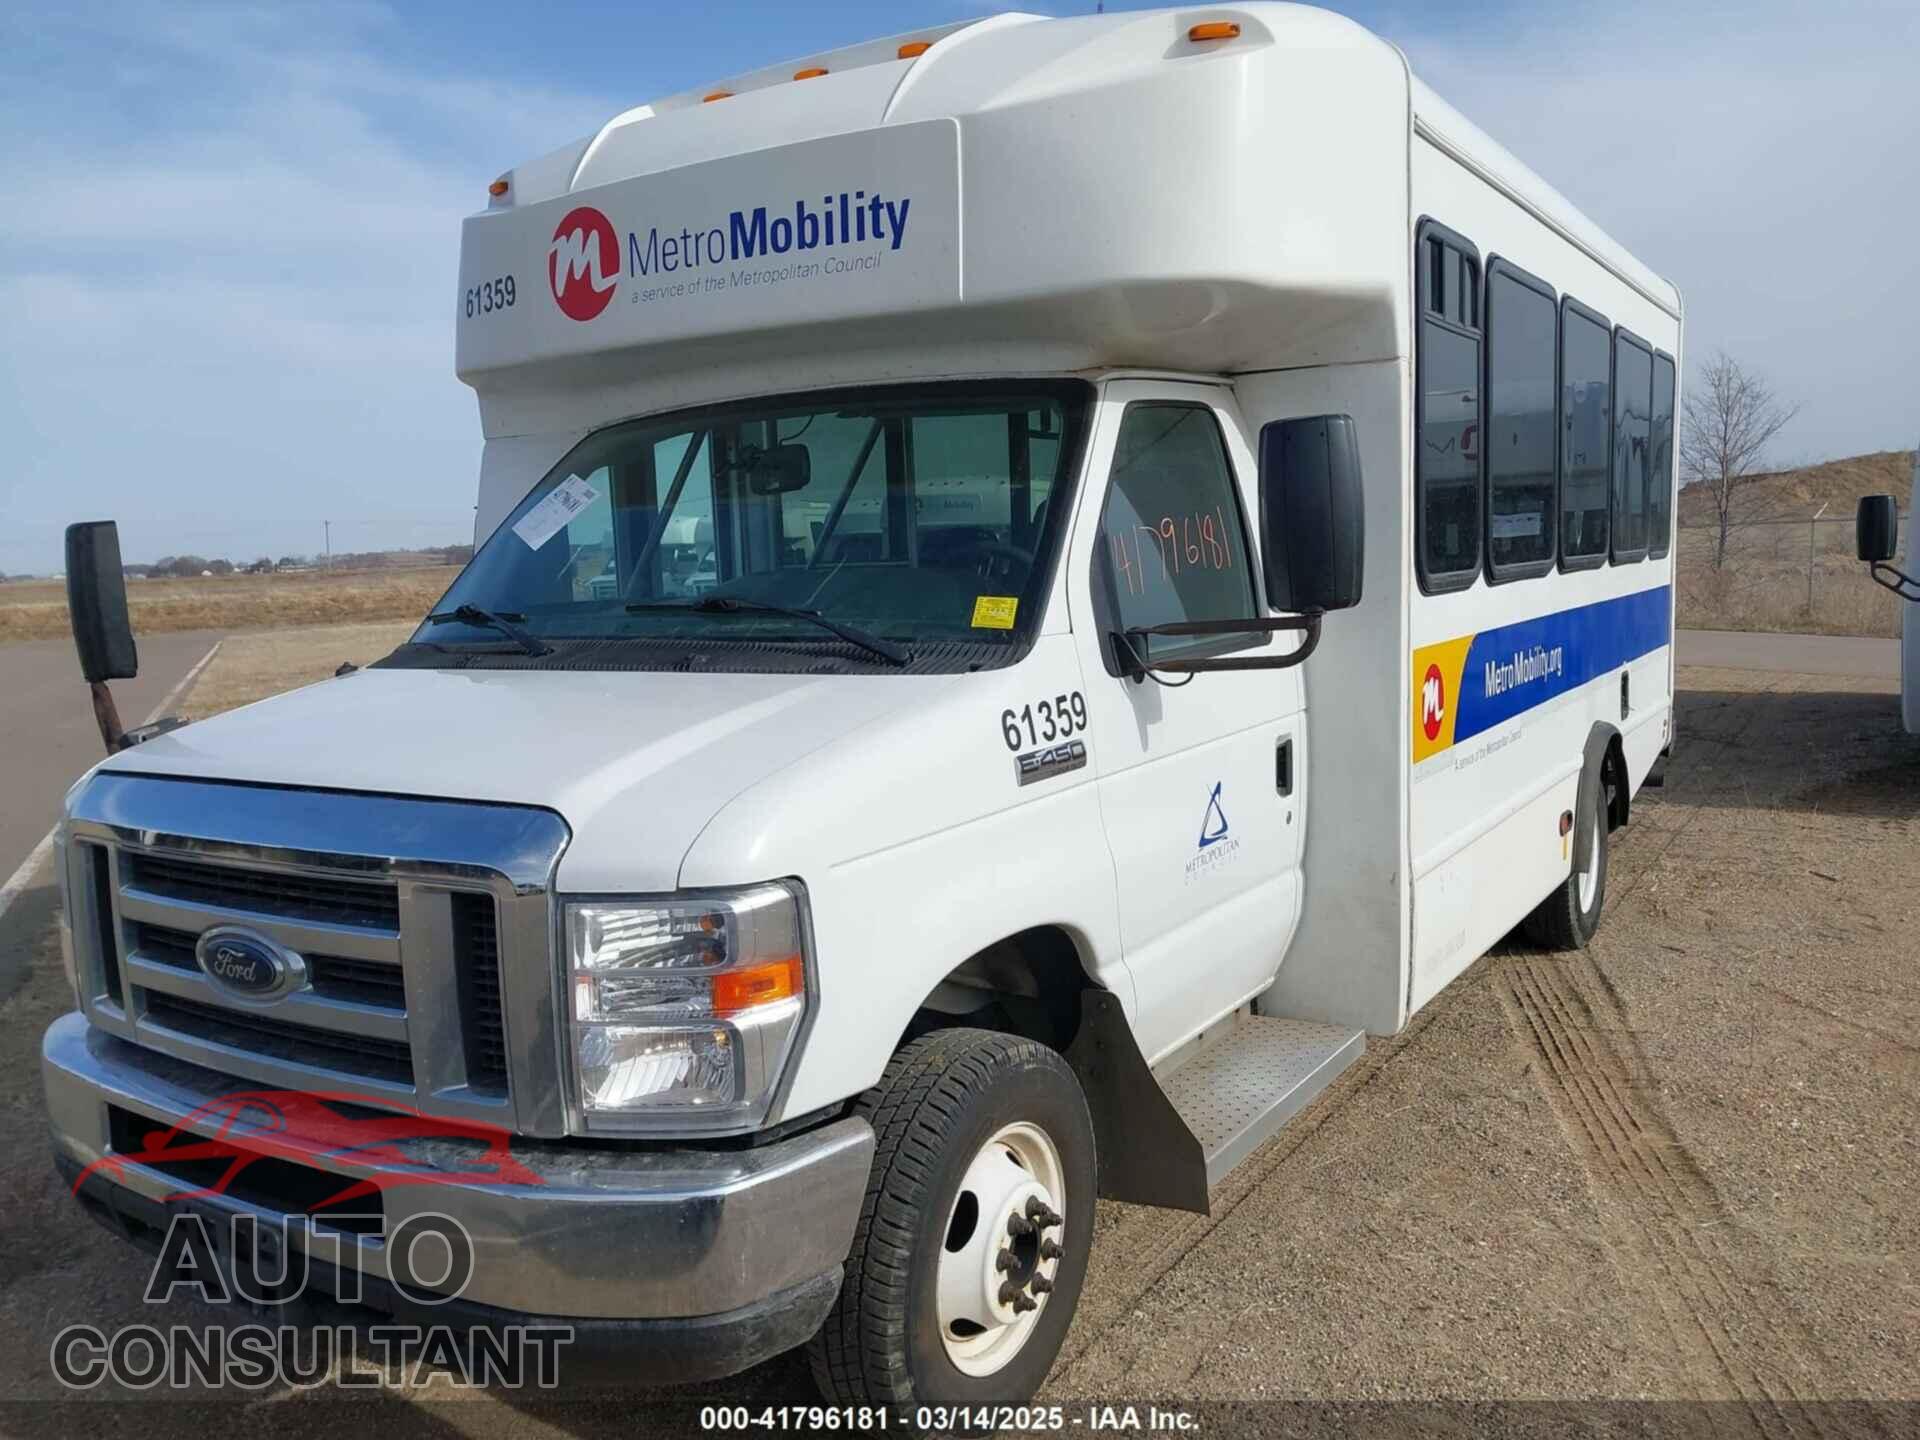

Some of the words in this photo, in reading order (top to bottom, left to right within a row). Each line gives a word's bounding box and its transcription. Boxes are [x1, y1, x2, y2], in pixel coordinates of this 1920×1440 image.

[629, 190, 911, 278] MetroMobility
[466, 274, 517, 318] 61359
[631, 292, 639, 304] a
[641, 283, 685, 303] service
[688, 279, 702, 295] of
[704, 275, 726, 293] the
[730, 263, 820, 287] Metropolitan
[824, 251, 882, 275] Council
[1113, 505, 1232, 596] 41796181
[1485, 645, 1562, 698] MetroMobility.org
[1001, 691, 1087, 751] 61359
[214, 947, 256, 983] Ford
